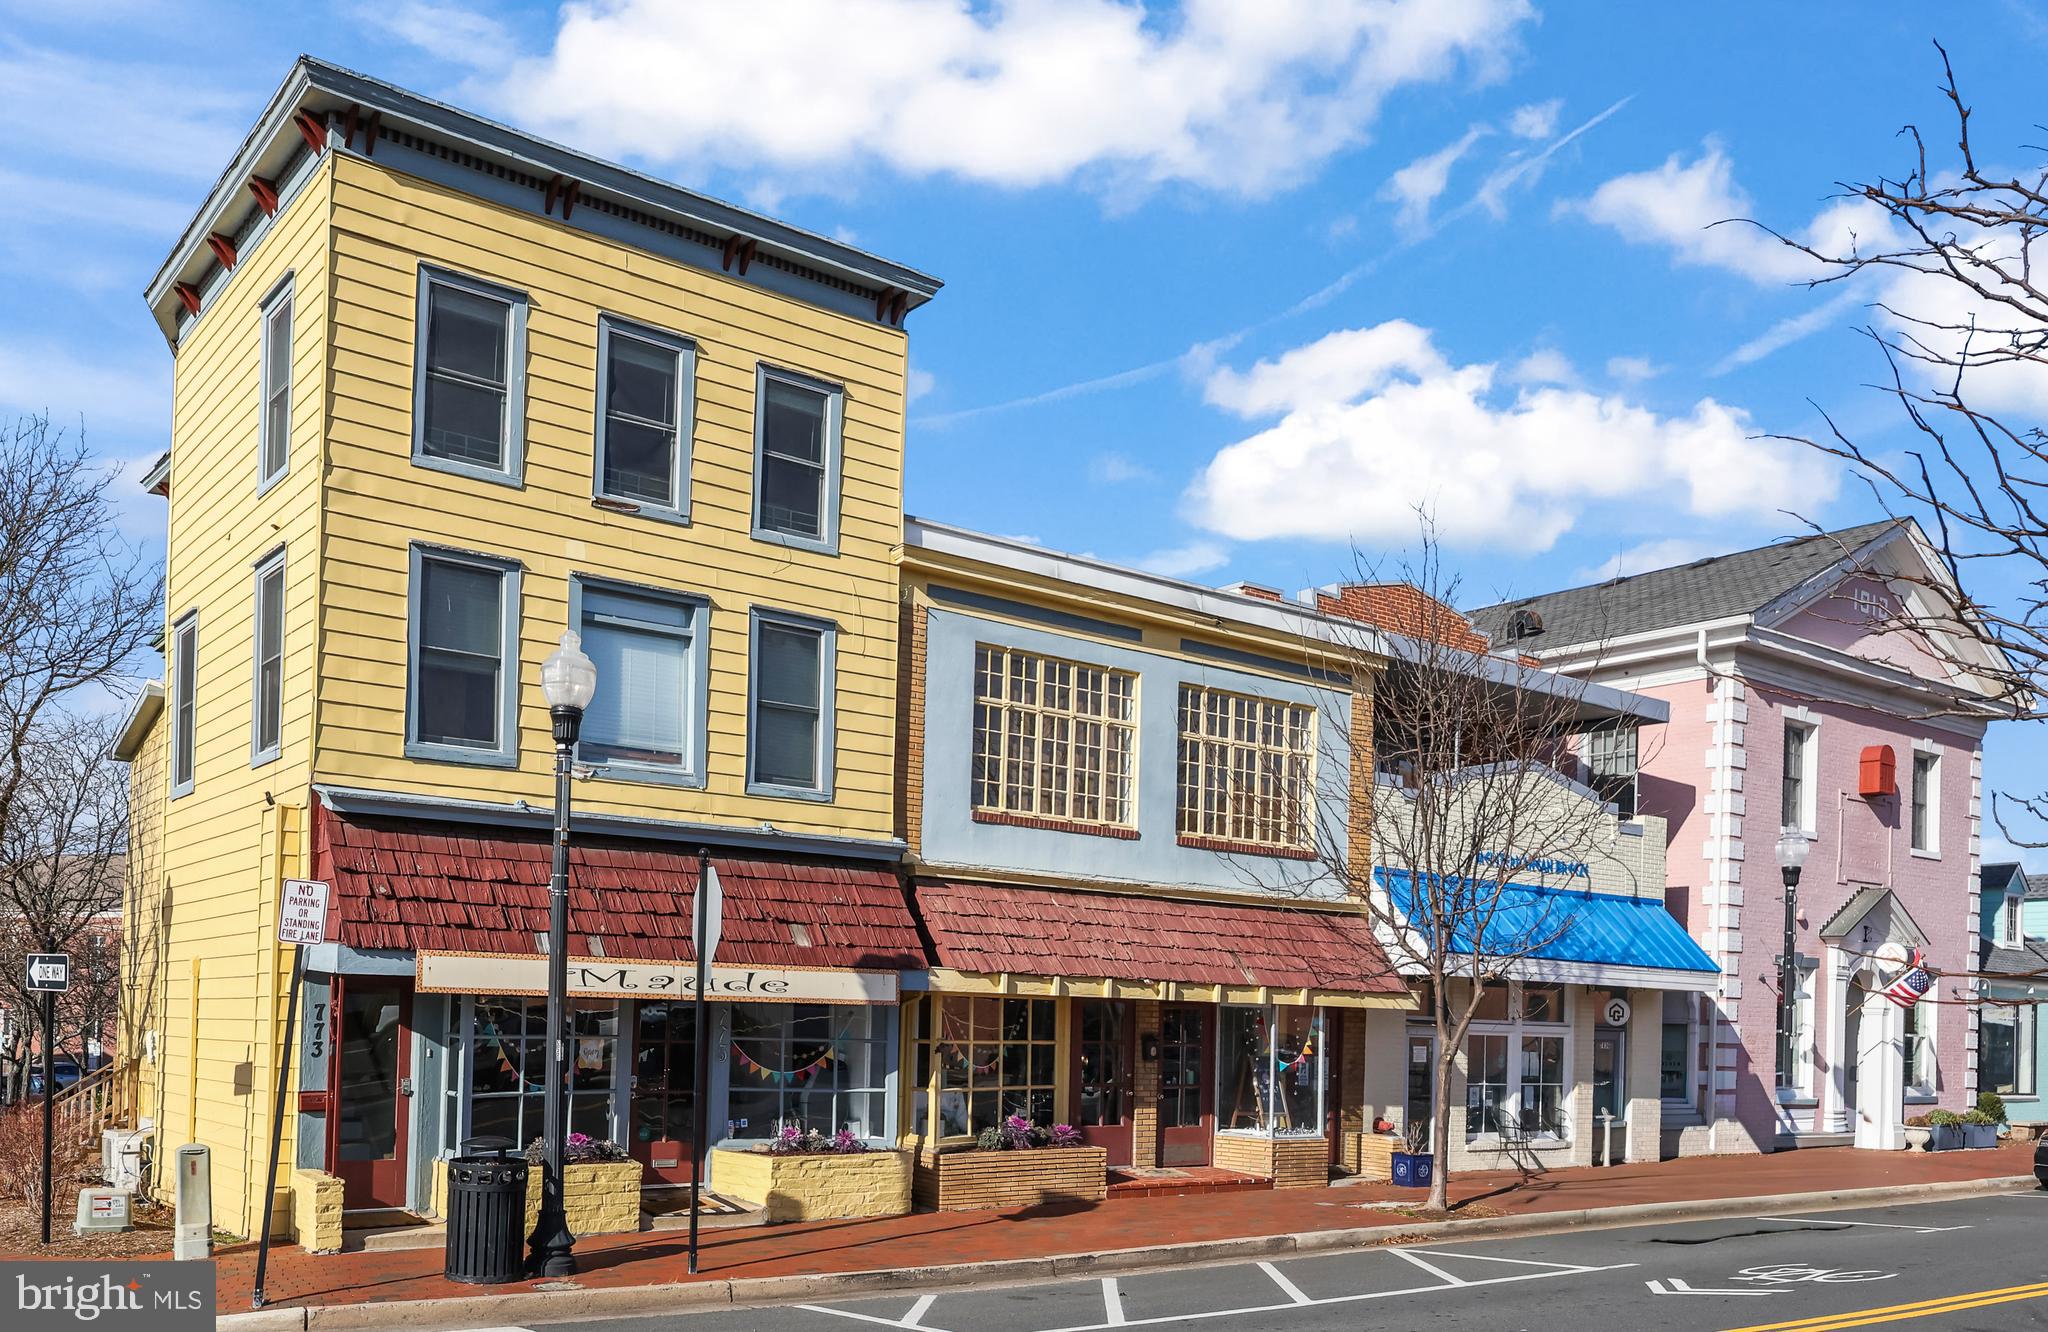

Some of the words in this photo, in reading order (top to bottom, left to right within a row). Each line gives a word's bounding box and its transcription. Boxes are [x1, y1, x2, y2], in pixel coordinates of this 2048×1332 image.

[298, 885, 314, 896] NO
[289, 896, 320, 908] PARKING
[298, 908, 309, 918] OR
[284, 918, 320, 930] STANDING
[281, 929, 298, 938] FIRE
[300, 931, 320, 941] LANE
[39, 966, 50, 978] ONE
[52, 966, 64, 979] WAY
[566, 967, 790, 993] Maude
[311, 1003, 326, 1058] 773
